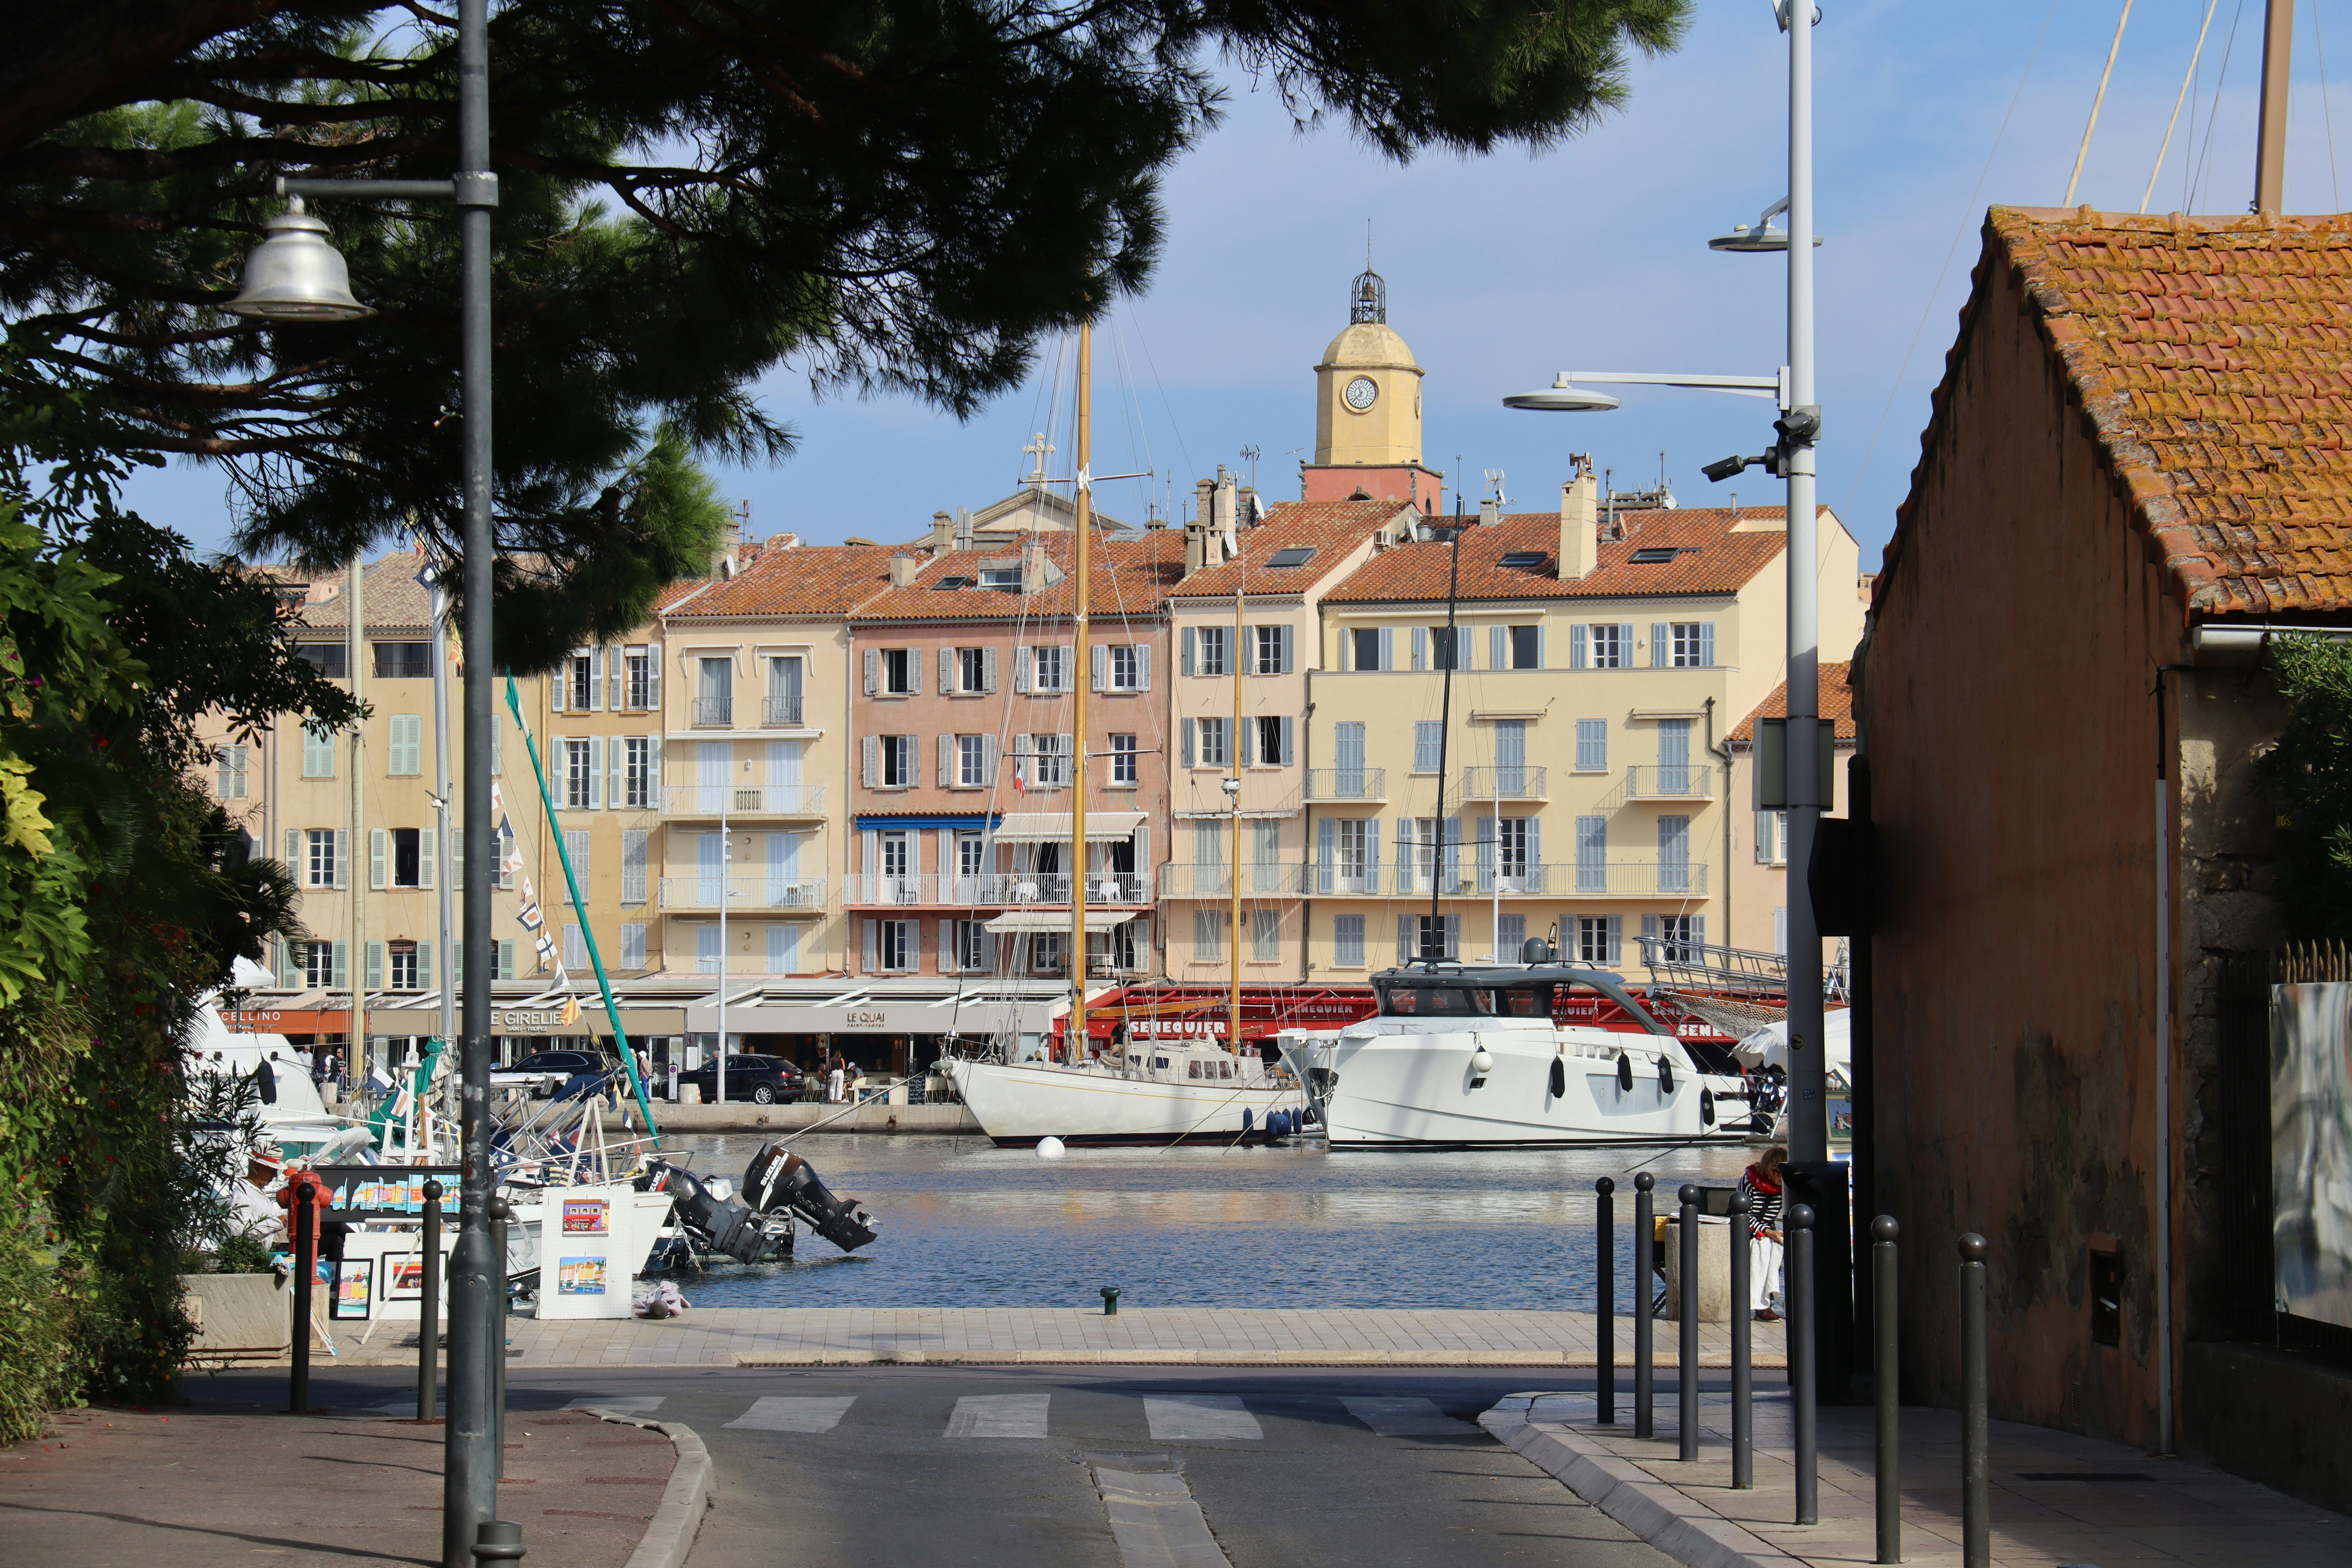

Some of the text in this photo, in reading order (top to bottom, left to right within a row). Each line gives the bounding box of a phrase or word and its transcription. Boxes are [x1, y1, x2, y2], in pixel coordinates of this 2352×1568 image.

[221, 1012, 280, 1020] CELLINO
[491, 1012, 562, 1024] E GIRELIE
[847, 1013, 885, 1022] LE QUAI
[760, 1155, 782, 1186] SUZUKI
